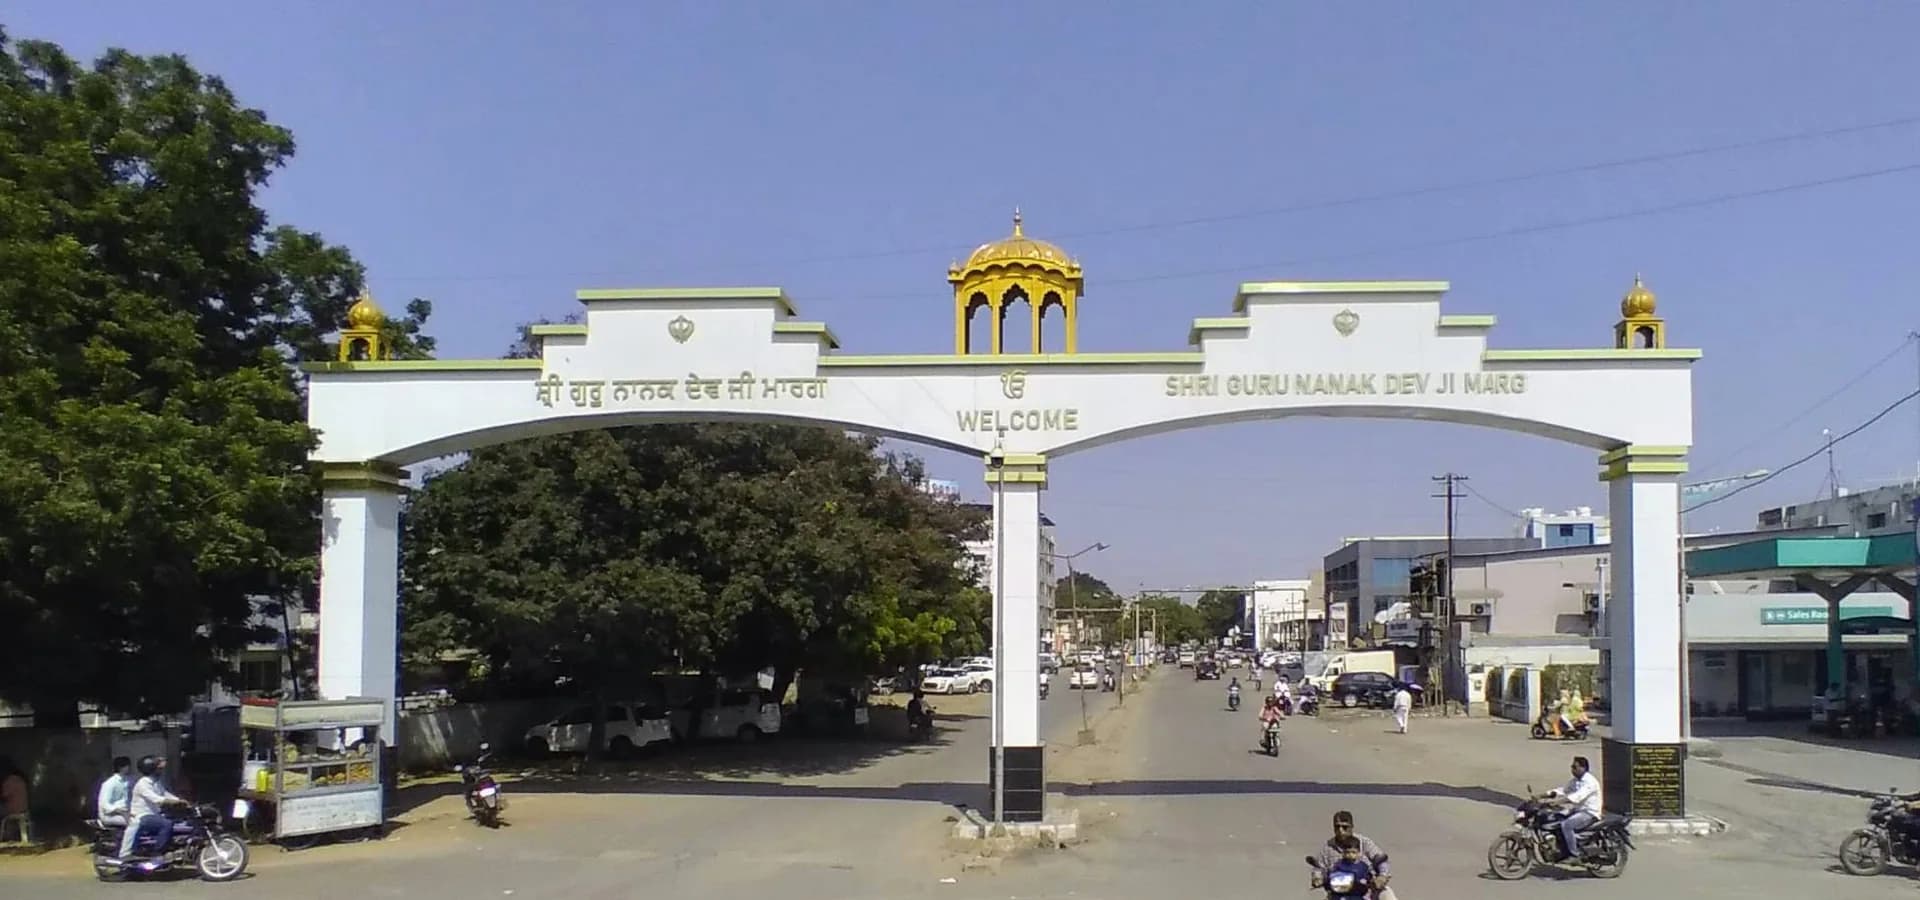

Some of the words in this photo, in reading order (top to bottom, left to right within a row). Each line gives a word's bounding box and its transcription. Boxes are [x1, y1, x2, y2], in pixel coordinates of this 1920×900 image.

[569, 380, 605, 408] ਗੁਰੂ
[612, 379, 678, 401] ਨਾਨਕ
[685, 372, 722, 400] ਦੇਵ
[728, 370, 756, 400] ਜੀ
[761, 377, 828, 399] ਮਾਰਗ
[1166, 374, 1218, 397] SHRI
[1227, 374, 1288, 396] GURU
[1296, 373, 1377, 396] NANAK
[1384, 372, 1430, 395] DEV
[1436, 372, 1454, 395] JI
[1464, 372, 1527, 395] MARG
[956, 409, 1078, 432] WELCOME
[1787, 610, 1809, 620] Sales
